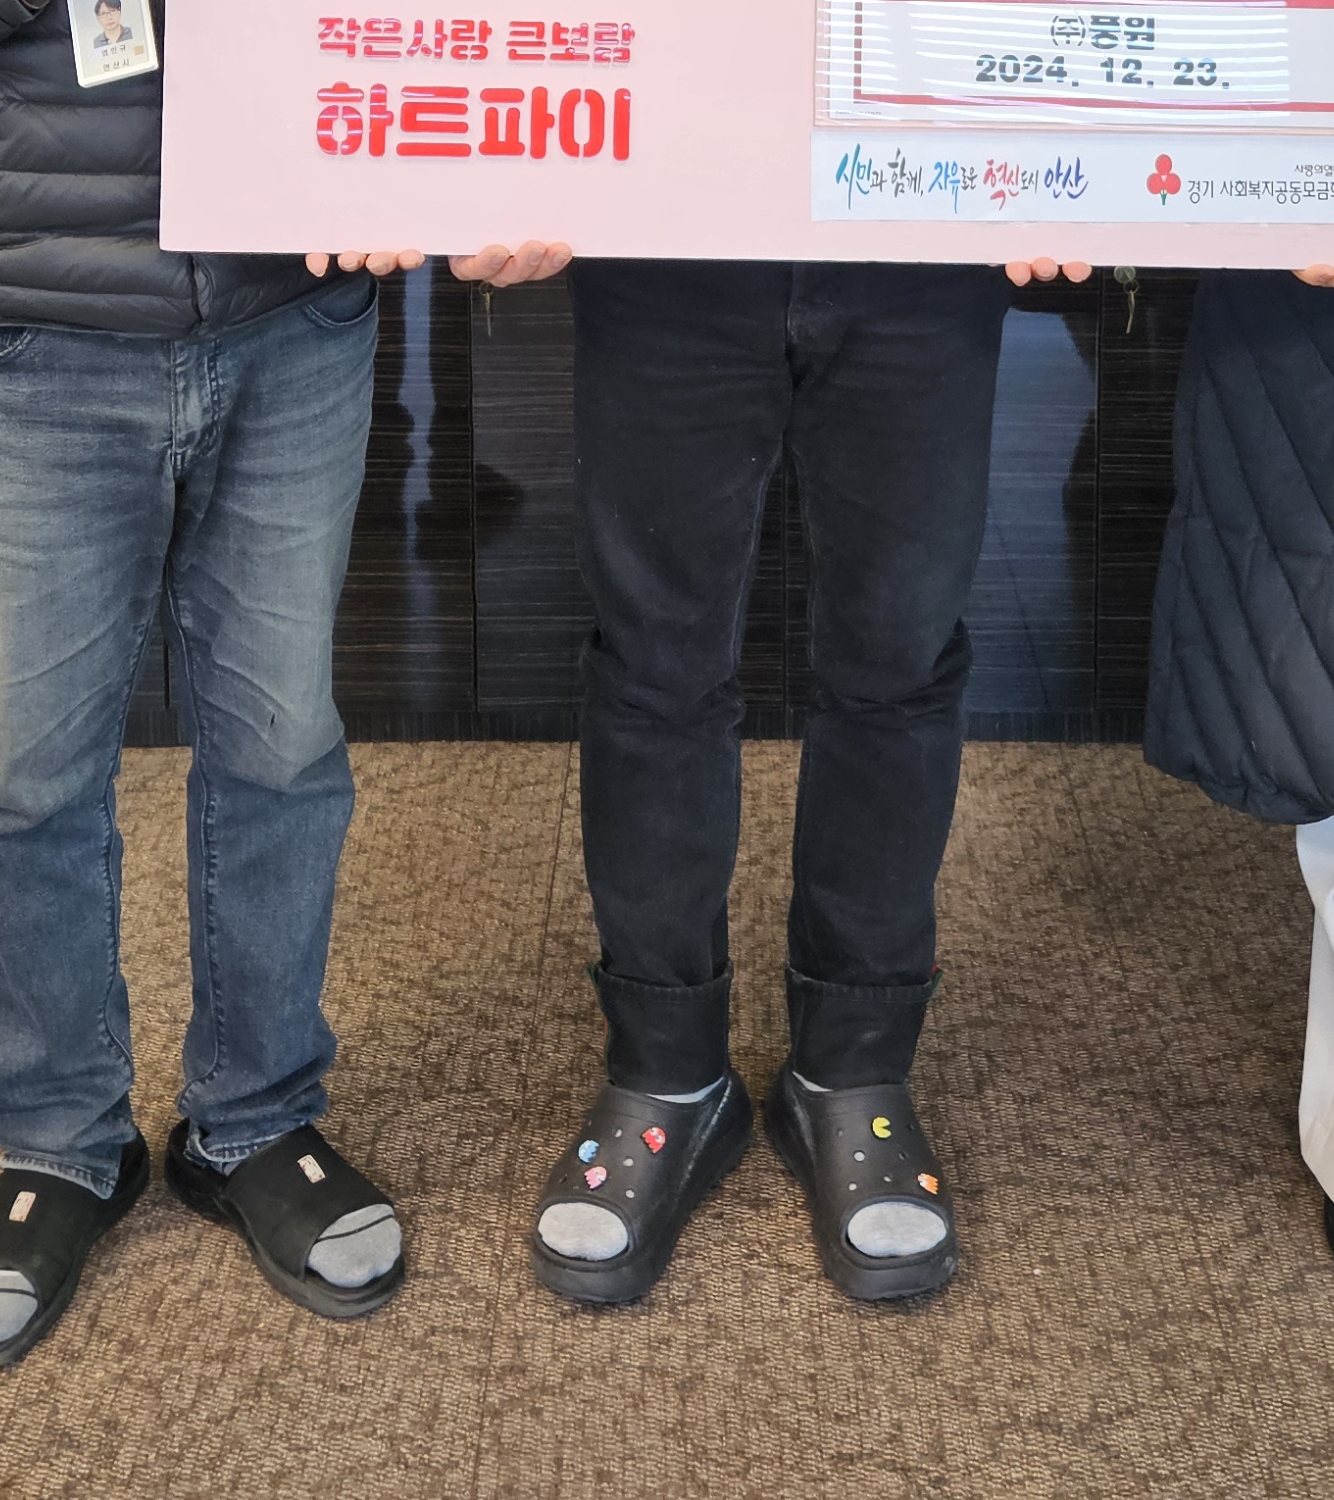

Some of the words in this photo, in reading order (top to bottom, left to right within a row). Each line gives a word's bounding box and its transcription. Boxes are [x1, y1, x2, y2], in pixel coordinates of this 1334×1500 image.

[317, 16, 492, 61] 작은사랑
[506, 19, 637, 66] 큰보람
[975, 54, 1079, 87] 2024.
[1099, 57, 1155, 89] 12.
[1173, 57, 1230, 90] 23.
[316, 81, 633, 161] 하트파이
[835, 143, 886, 210] 시민과
[927, 161, 978, 214] 자유로운
[983, 159, 1039, 211] 혁신도시
[1043, 156, 1089, 199] 안산
[1187, 180, 1214, 204] 경기
